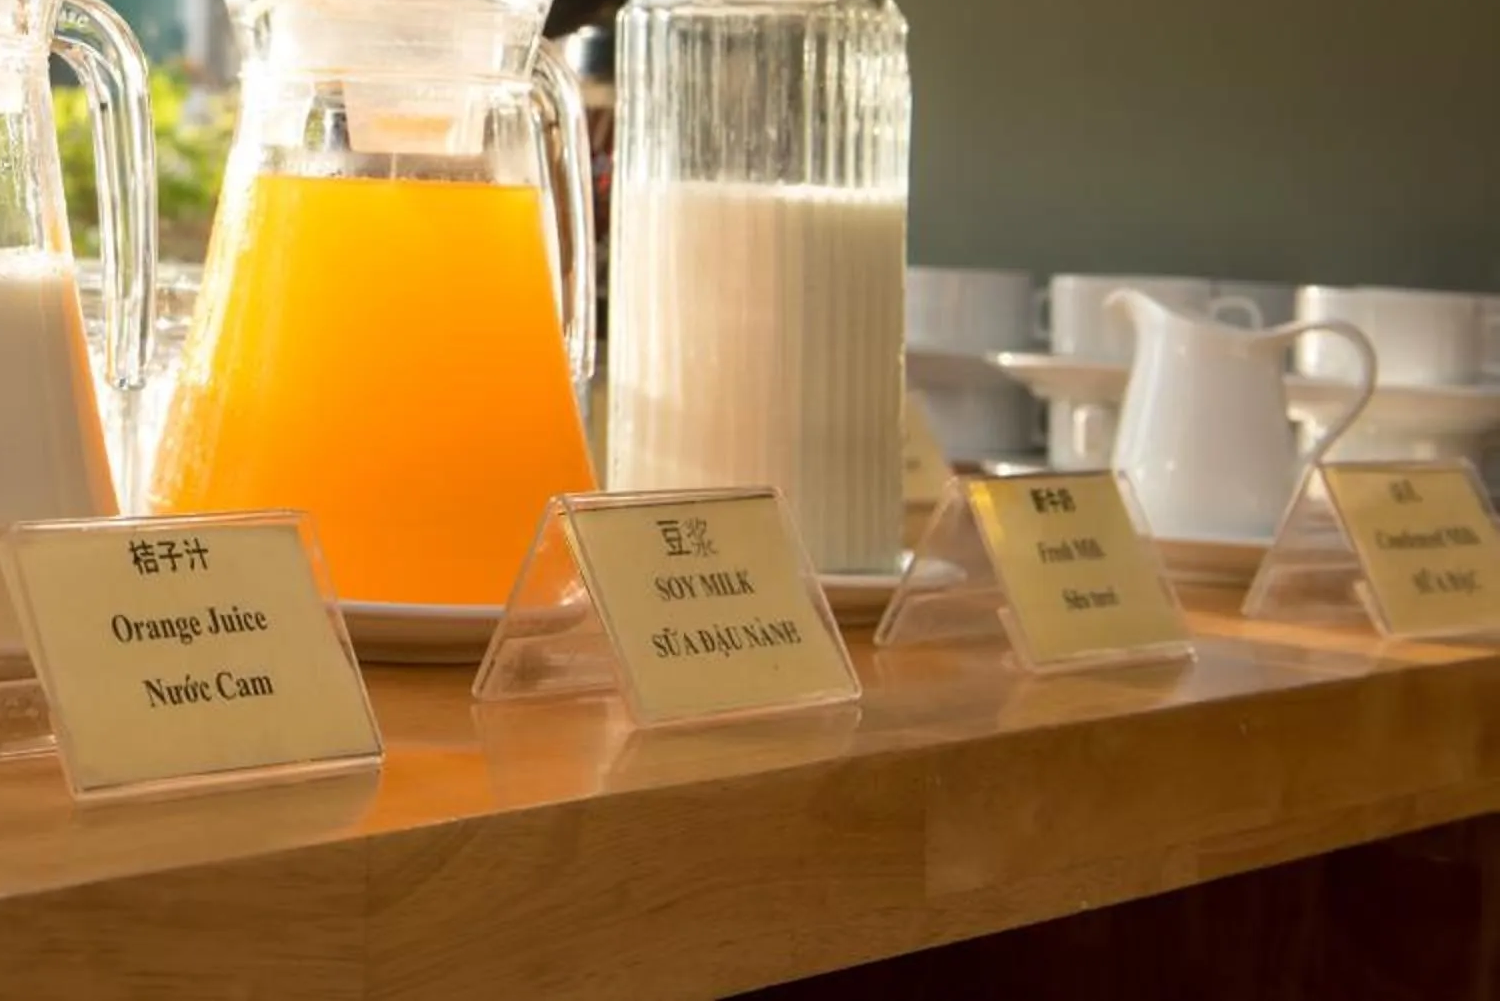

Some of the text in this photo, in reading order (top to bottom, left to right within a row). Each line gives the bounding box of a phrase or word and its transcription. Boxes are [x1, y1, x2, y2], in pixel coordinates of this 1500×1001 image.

[129, 537, 209, 575] 桔子汁
[656, 517, 718, 557] 豆浆
[654, 568, 755, 601] SOY MILK
[111, 605, 268, 645] Orange Juice
[143, 670, 274, 708] Nước Cam
